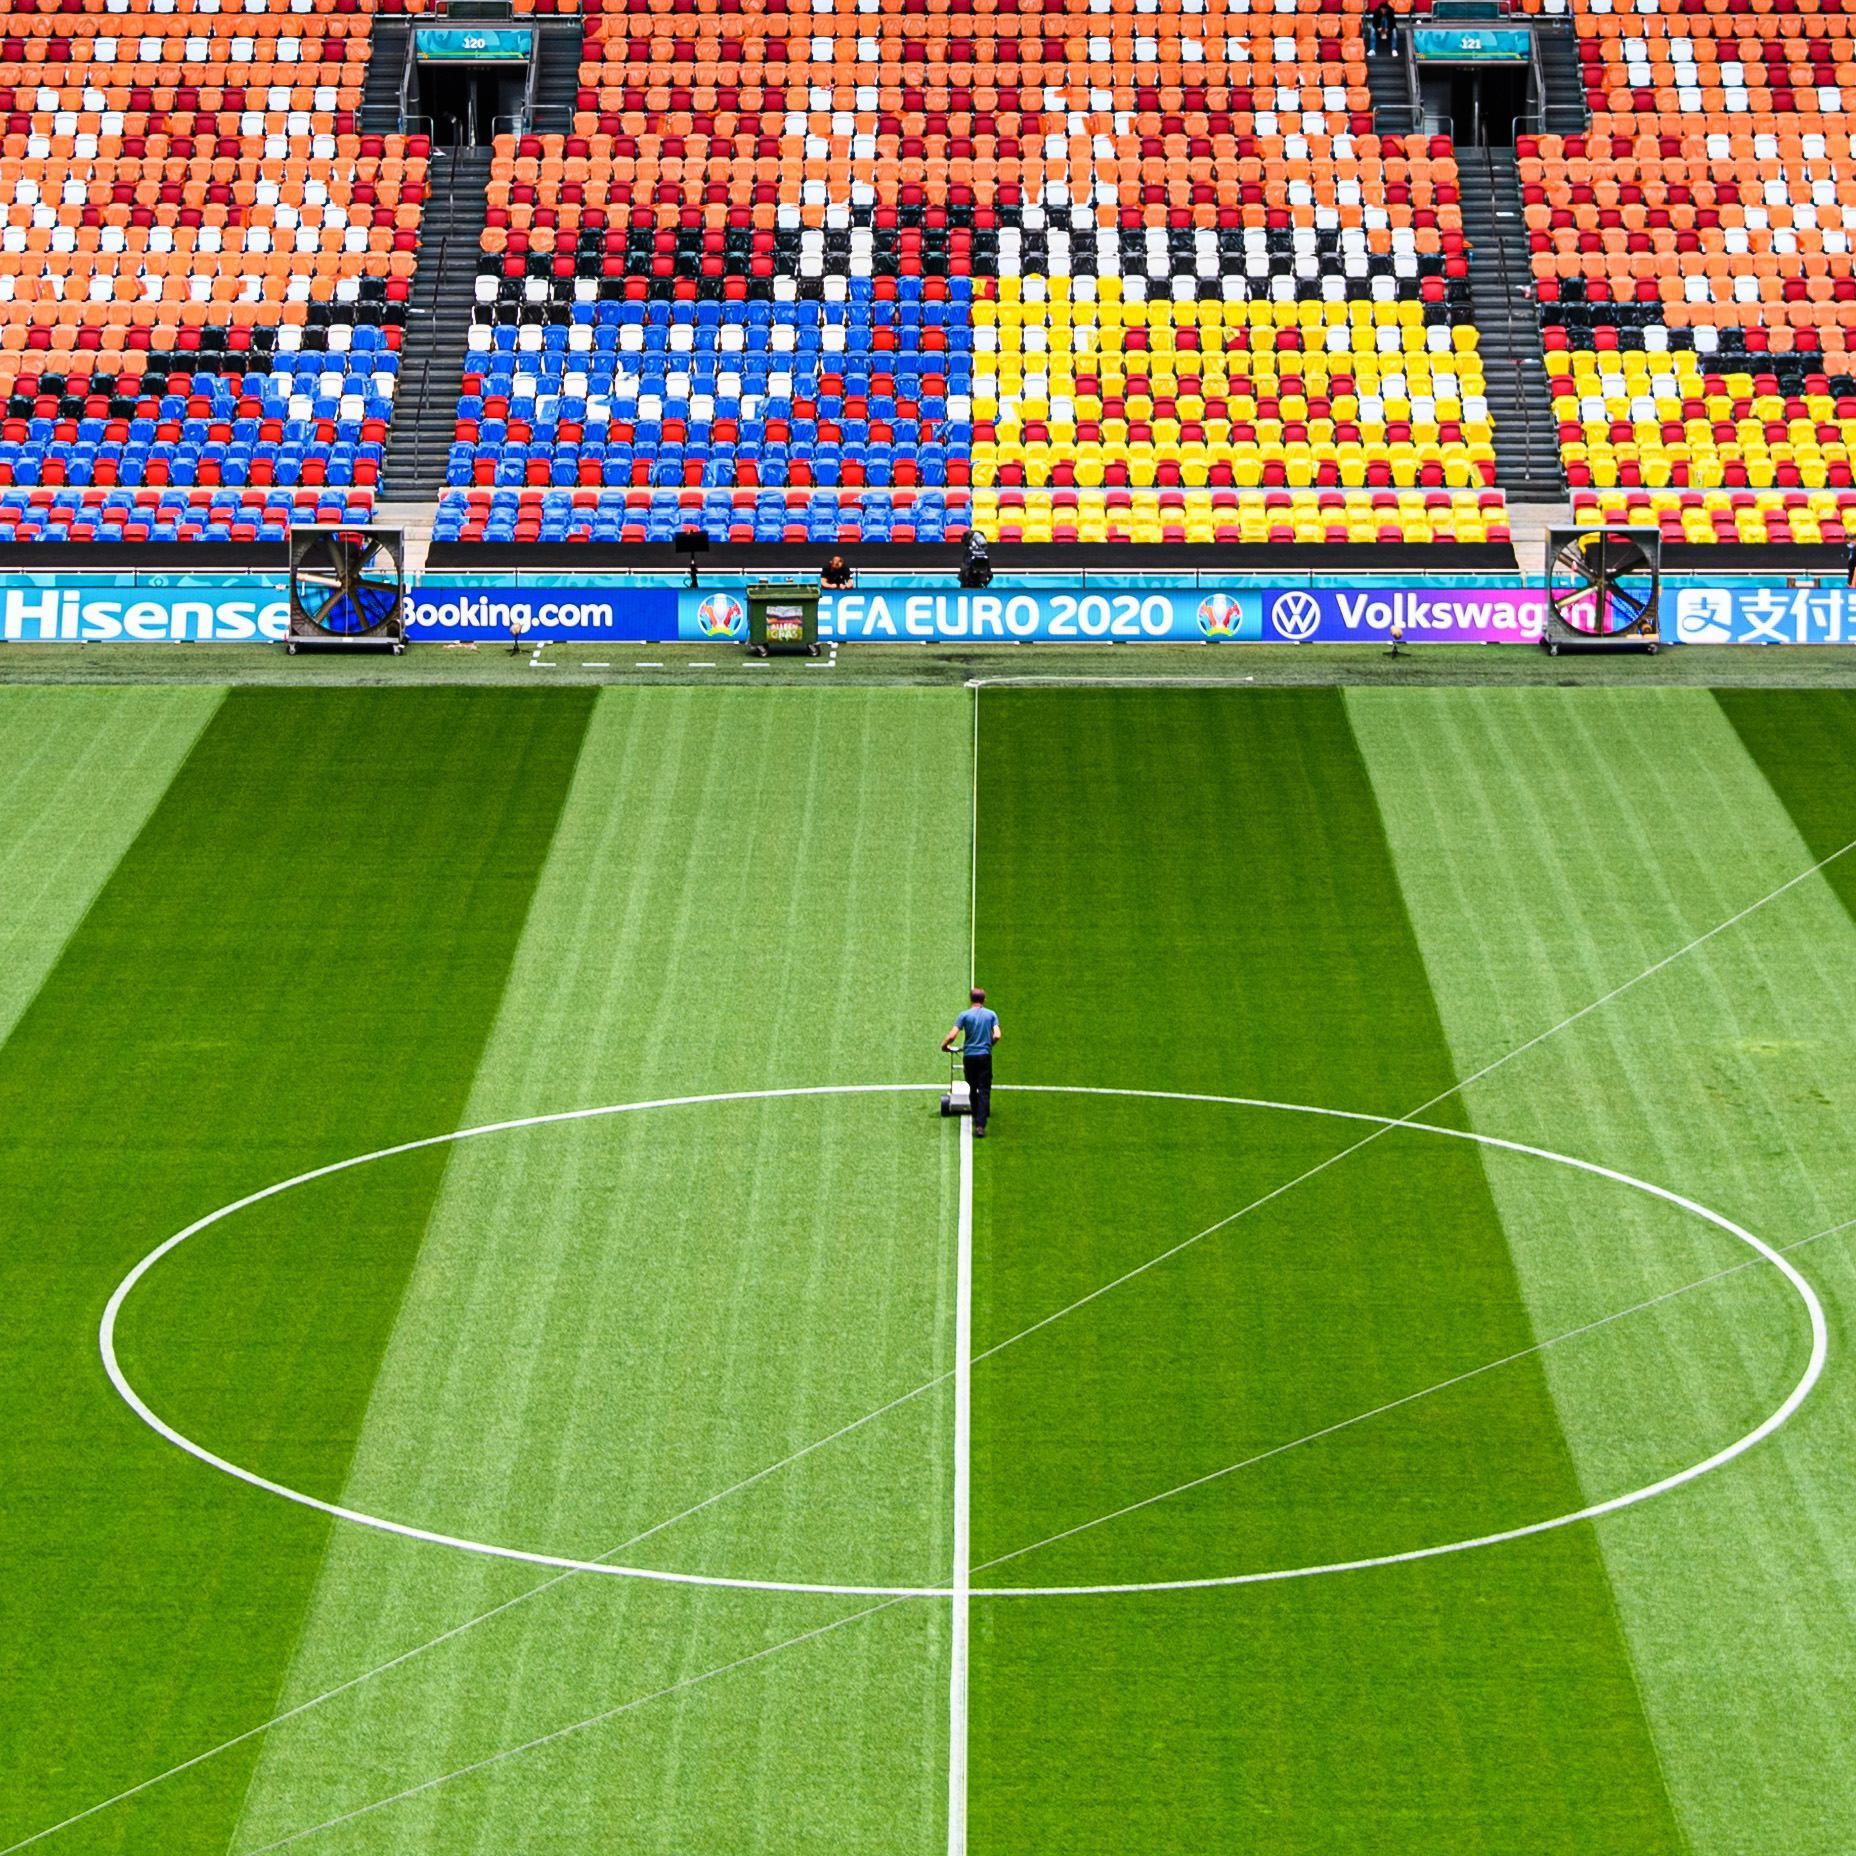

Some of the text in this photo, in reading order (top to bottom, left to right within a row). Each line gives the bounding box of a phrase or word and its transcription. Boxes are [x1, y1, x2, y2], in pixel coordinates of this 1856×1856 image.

[464, 38, 486, 49] 120
[1461, 38, 1481, 49] 121
[4, 590, 291, 639] Hisense
[403, 595, 613, 630] Booking.com
[817, 595, 1173, 635] EFA EURO 2020
[1336, 592, 1596, 638] Volkswagn
